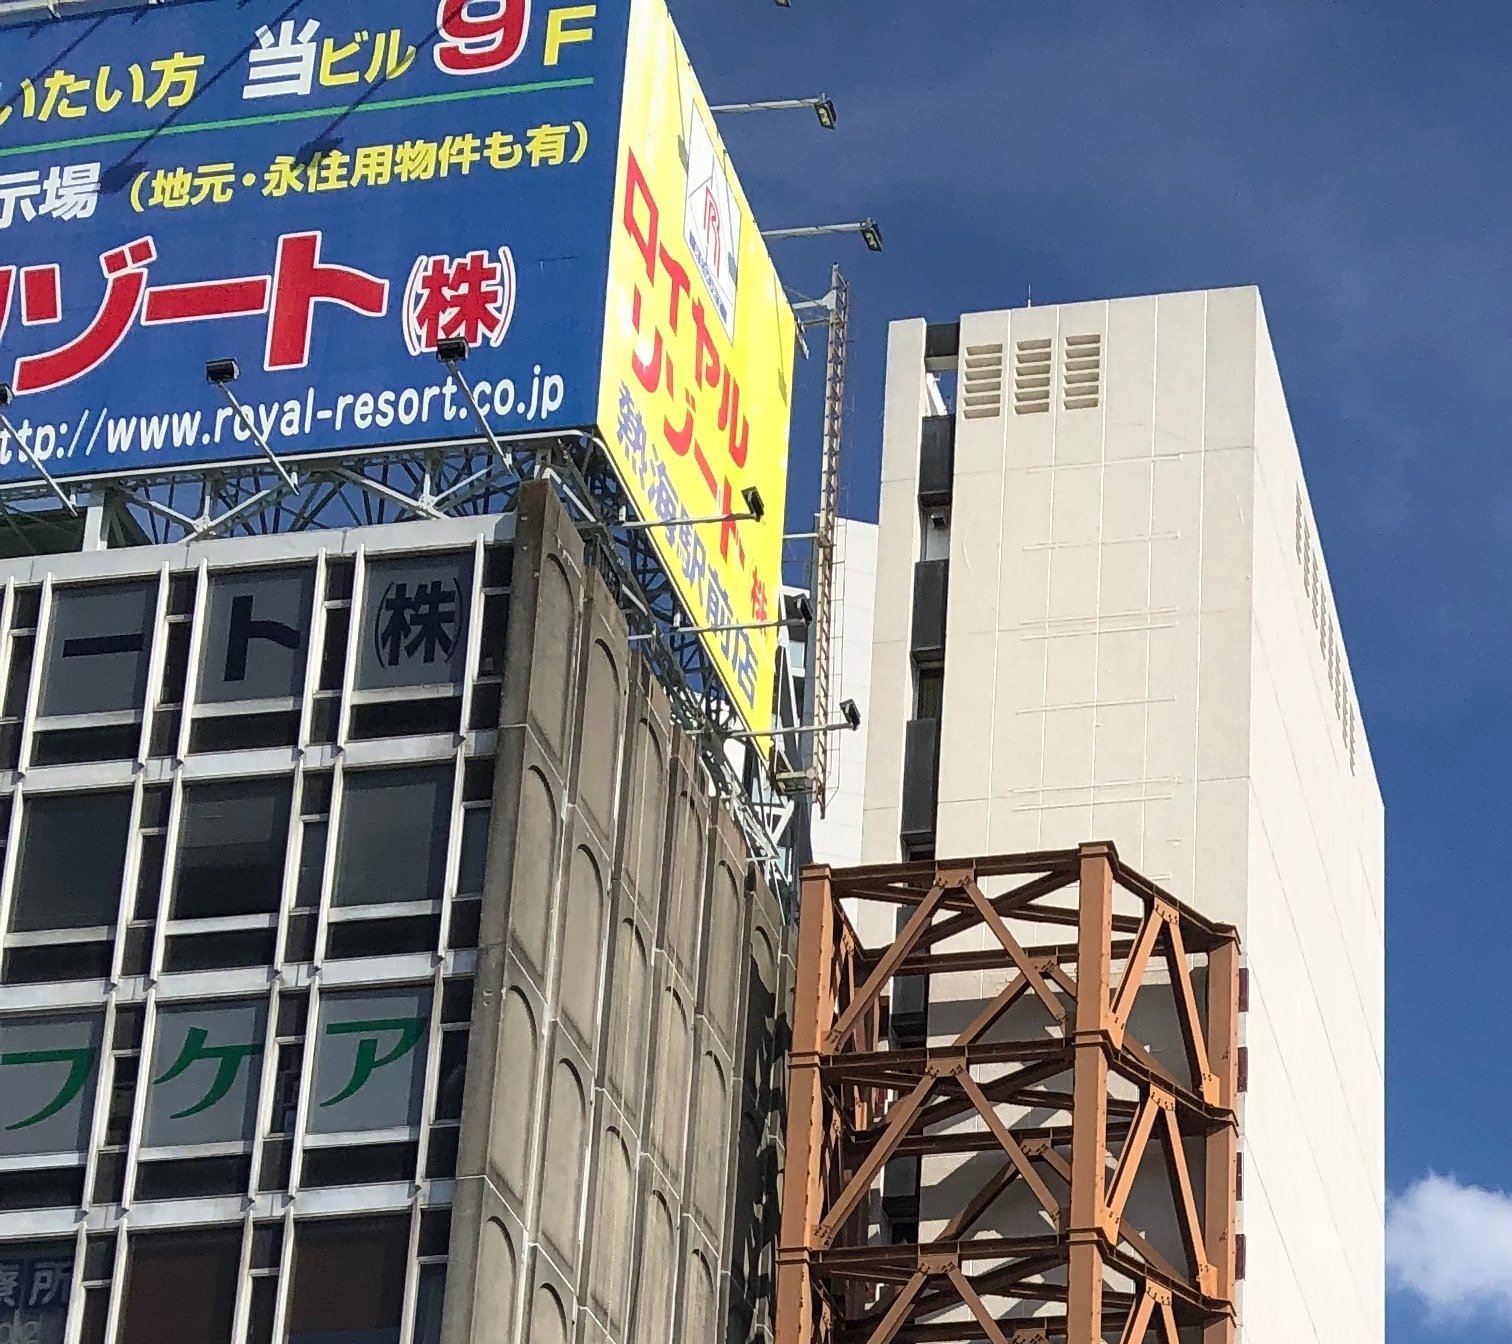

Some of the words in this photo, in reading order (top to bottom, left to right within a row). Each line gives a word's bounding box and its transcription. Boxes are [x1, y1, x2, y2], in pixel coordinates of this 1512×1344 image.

[131, 120, 588, 213] (地元・永住用物件も有)
[242, 17, 415, 101] 当ビル
[0, 230, 517, 396] ゾート(株)
[623, 145, 750, 467] ロイヤル
[631, 283, 745, 570] リゾート
[617, 382, 759, 711] 熱海駅前店
